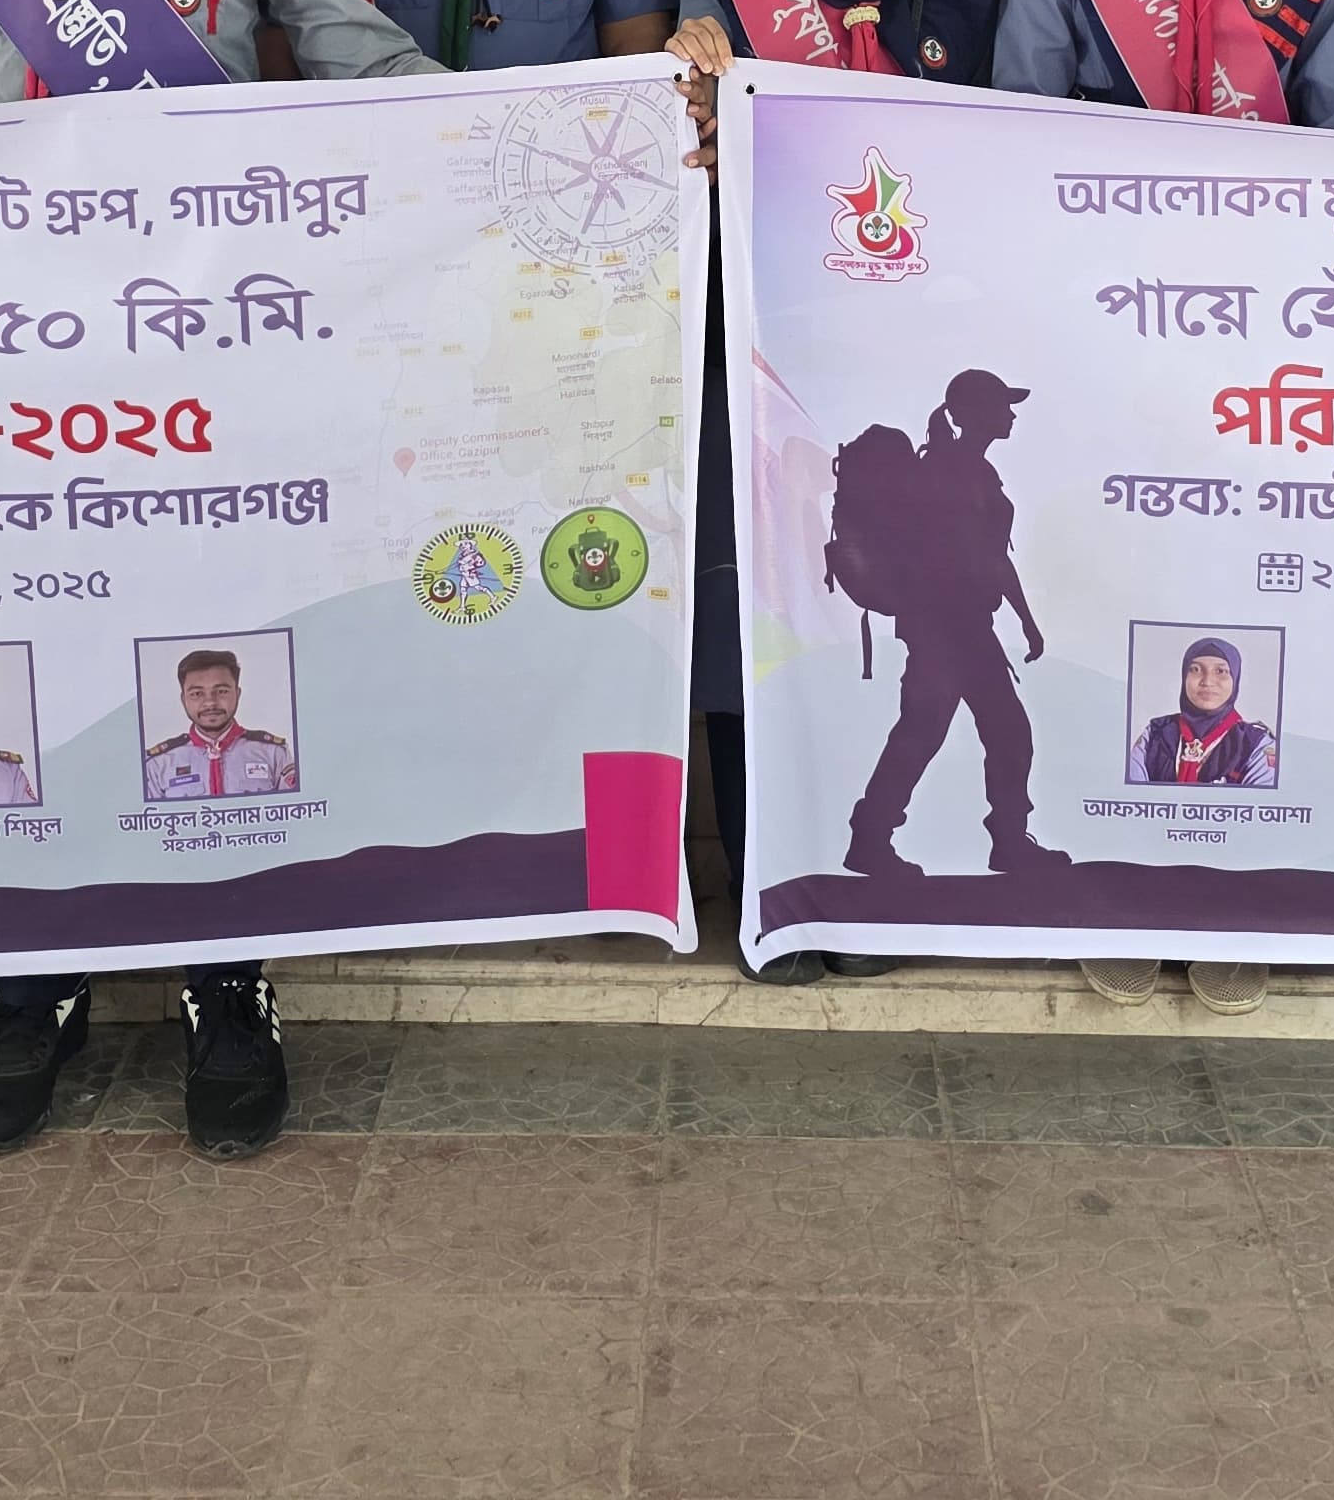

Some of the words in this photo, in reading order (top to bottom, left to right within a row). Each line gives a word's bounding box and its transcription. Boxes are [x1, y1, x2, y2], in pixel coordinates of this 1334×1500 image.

[44, 186, 154, 239] গ্রুপ,
[169, 164, 369, 239] গাজীপুর
[1054, 173, 1311, 218] অবলোকন
[115, 273, 336, 355] কি.মি.
[1095, 277, 1261, 341] পায়ে
[650, 376, 683, 385] Belabo
[419, 434, 459, 449] Deputy
[462, 425, 550, 445] Commissioner's
[458, 445, 502, 459] Gazipur
[63, 476, 330, 534] কিশোরগঞ্জ
[1102, 475, 1242, 518] গন্তব্য:
[381, 536, 414, 550] Tongi
[12, 570, 113, 602] ২০২৫
[4, 810, 63, 842] শিমুল
[118, 805, 200, 840] আতিকুল
[201, 799, 262, 832] ইসলাম
[264, 795, 329, 824] আকাশ
[1083, 797, 1176, 822] আফসানা
[1180, 799, 1256, 826] আক্তার
[1258, 801, 1313, 826] আশা
[161, 831, 223, 856] সহকারী
[224, 828, 289, 850] দলনেতা
[1166, 825, 1227, 845] দলনেতা
